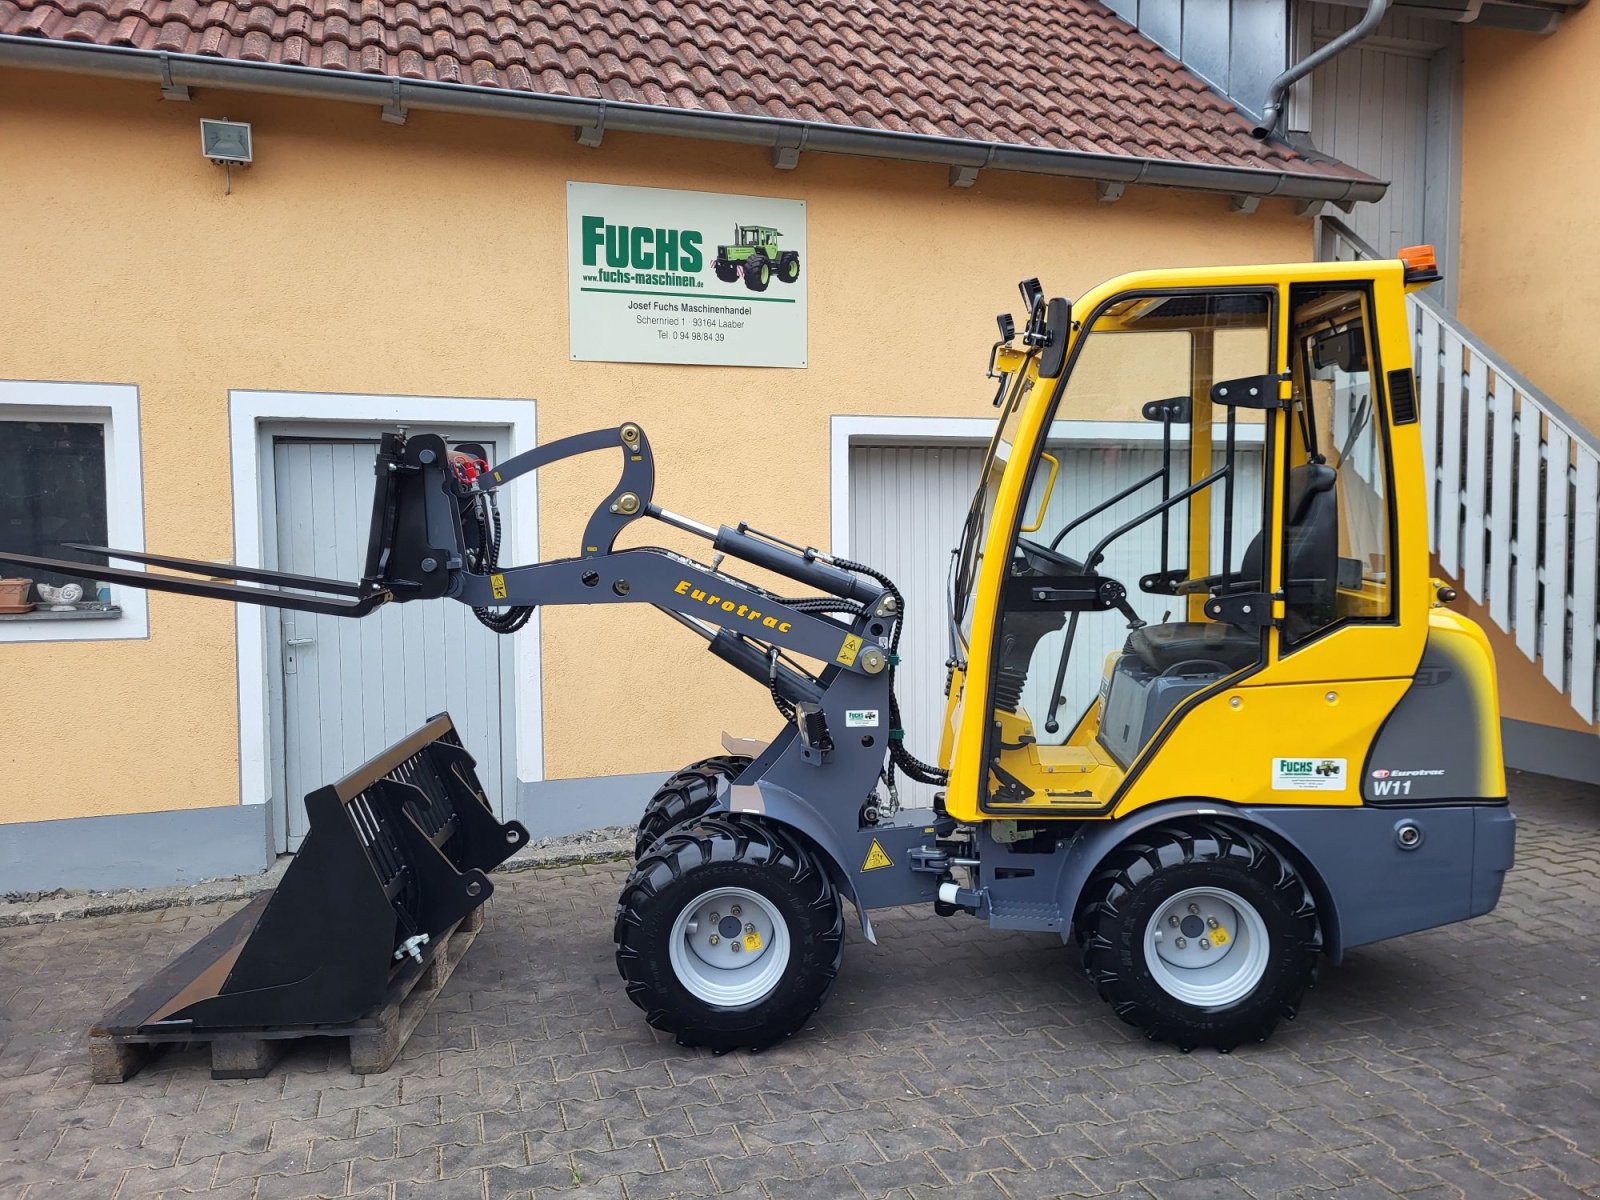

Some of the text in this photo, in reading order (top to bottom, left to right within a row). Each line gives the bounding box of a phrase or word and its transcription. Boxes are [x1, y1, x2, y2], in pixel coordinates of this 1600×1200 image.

[582, 216, 703, 272] FUCHS
[628, 300, 752, 315] Josef Fuchs Maschinenhandel
[636, 315, 679, 326] Schernried
[692, 318, 717, 328] 93164
[718, 319, 745, 329] Laaber
[657, 330, 725, 342] Tel. 0 94 98/84 39
[674, 580, 792, 633] Eurotrac
[1280, 760, 1313, 773] FUCHS
[1391, 769, 1446, 777] Eurotrac
[1373, 780, 1412, 796] W11
